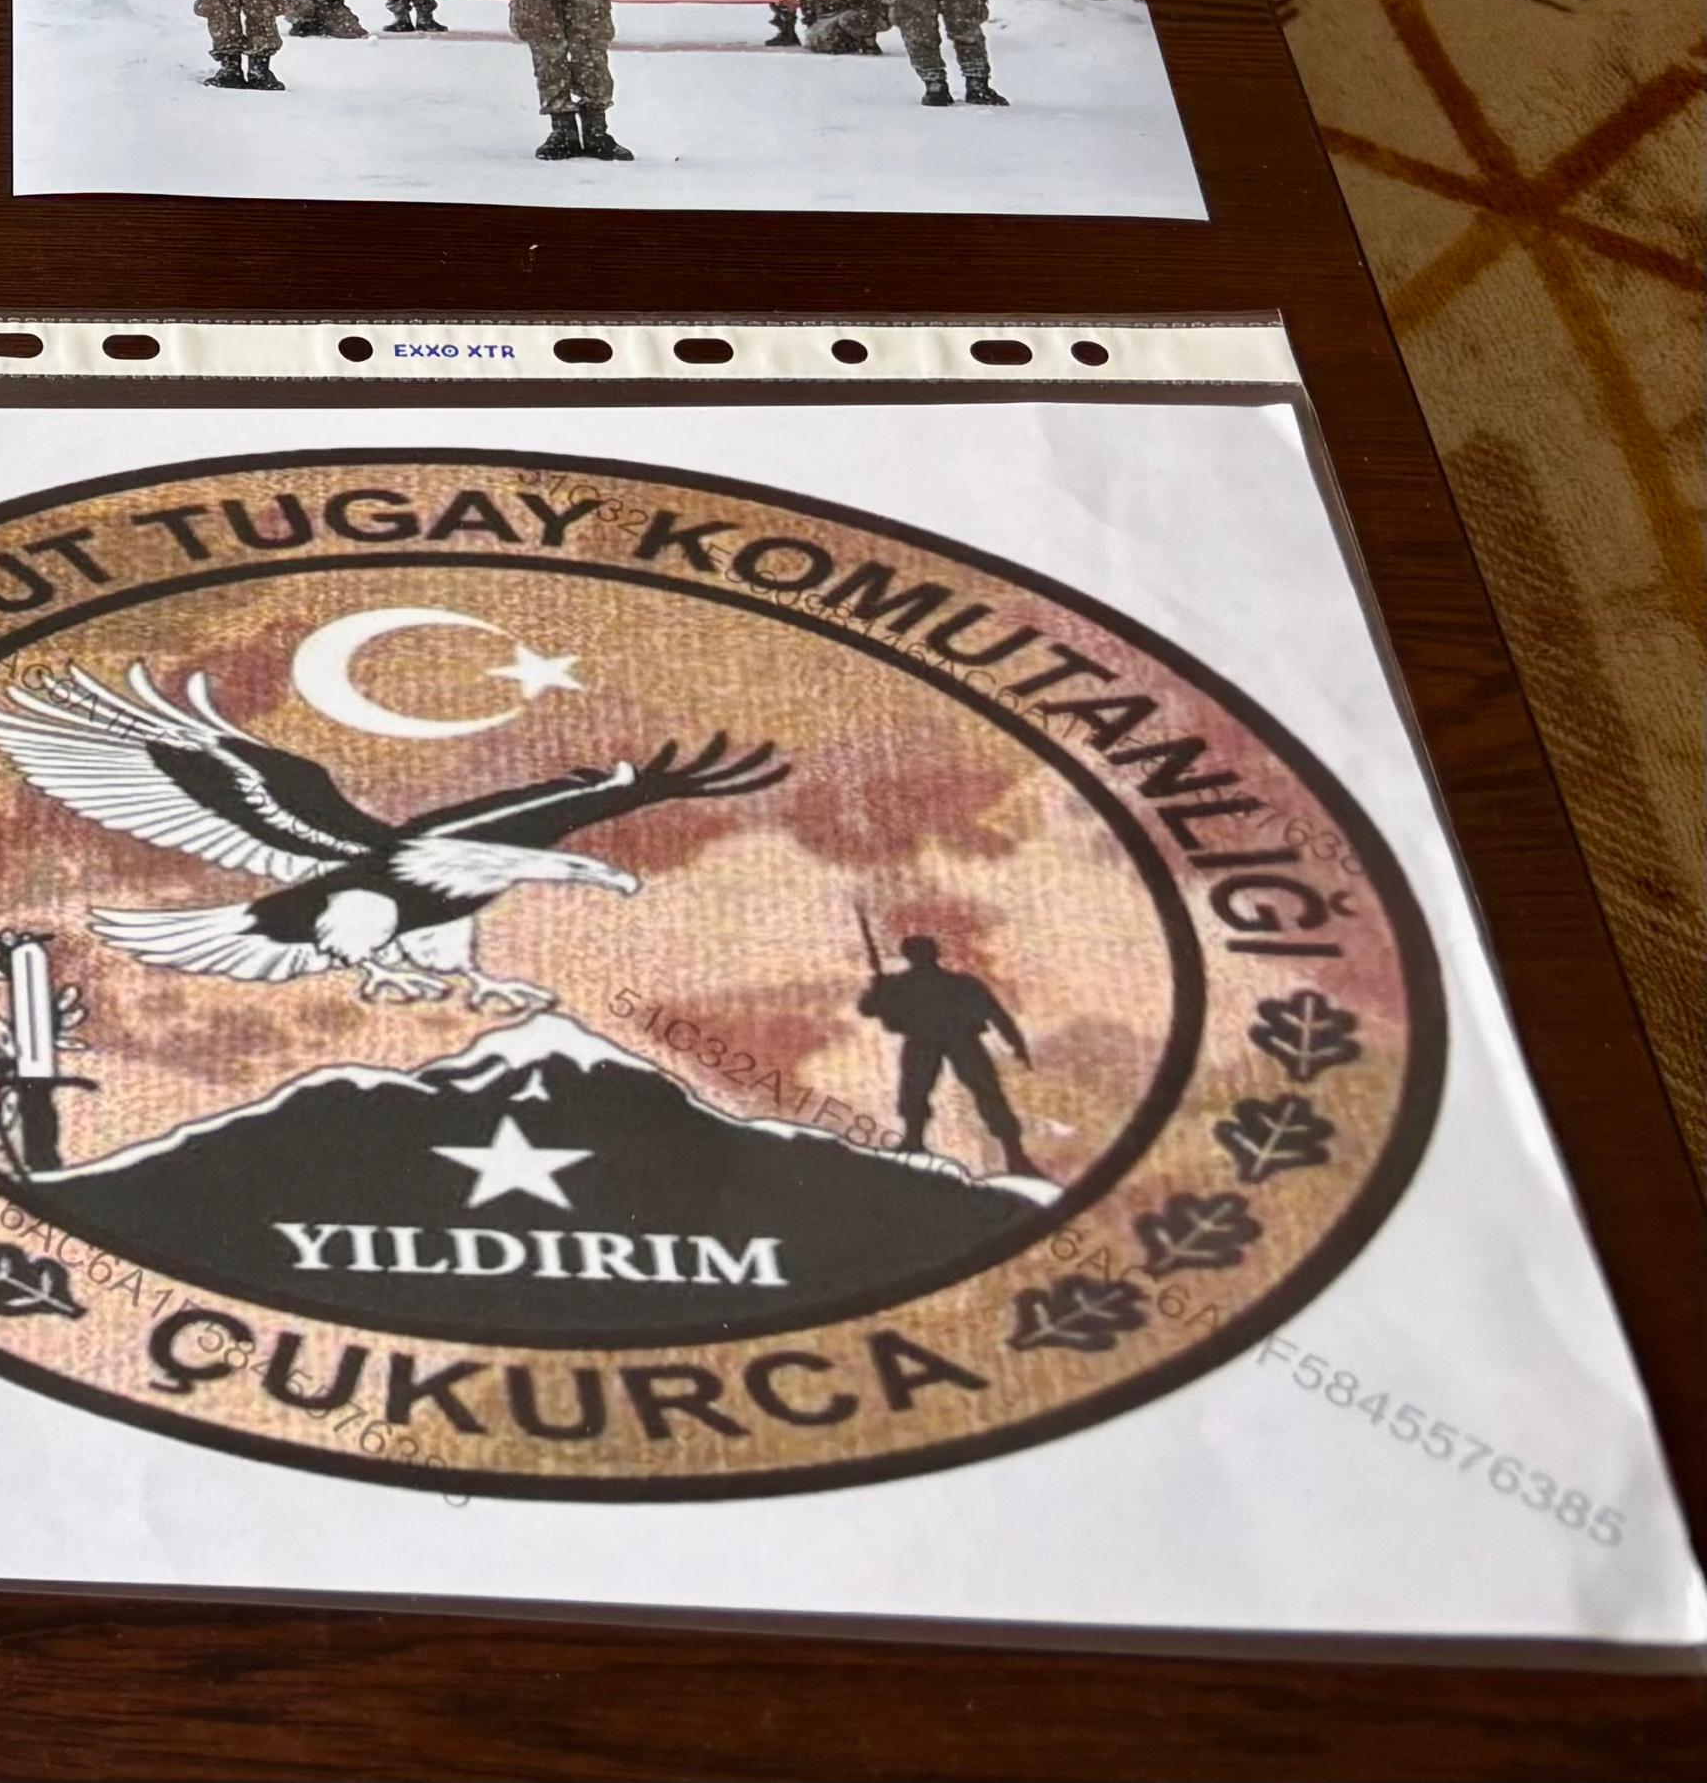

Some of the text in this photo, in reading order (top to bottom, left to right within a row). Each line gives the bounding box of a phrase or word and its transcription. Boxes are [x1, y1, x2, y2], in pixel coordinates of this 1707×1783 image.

[394, 344, 515, 358] EXXO XTR
[132, 488, 604, 563] TUGAY
[634, 509, 1356, 958] KOMUTANLIĞI
[275, 1221, 789, 1288] YILDIRIM
[148, 1309, 991, 1443] ÇUKURCA
